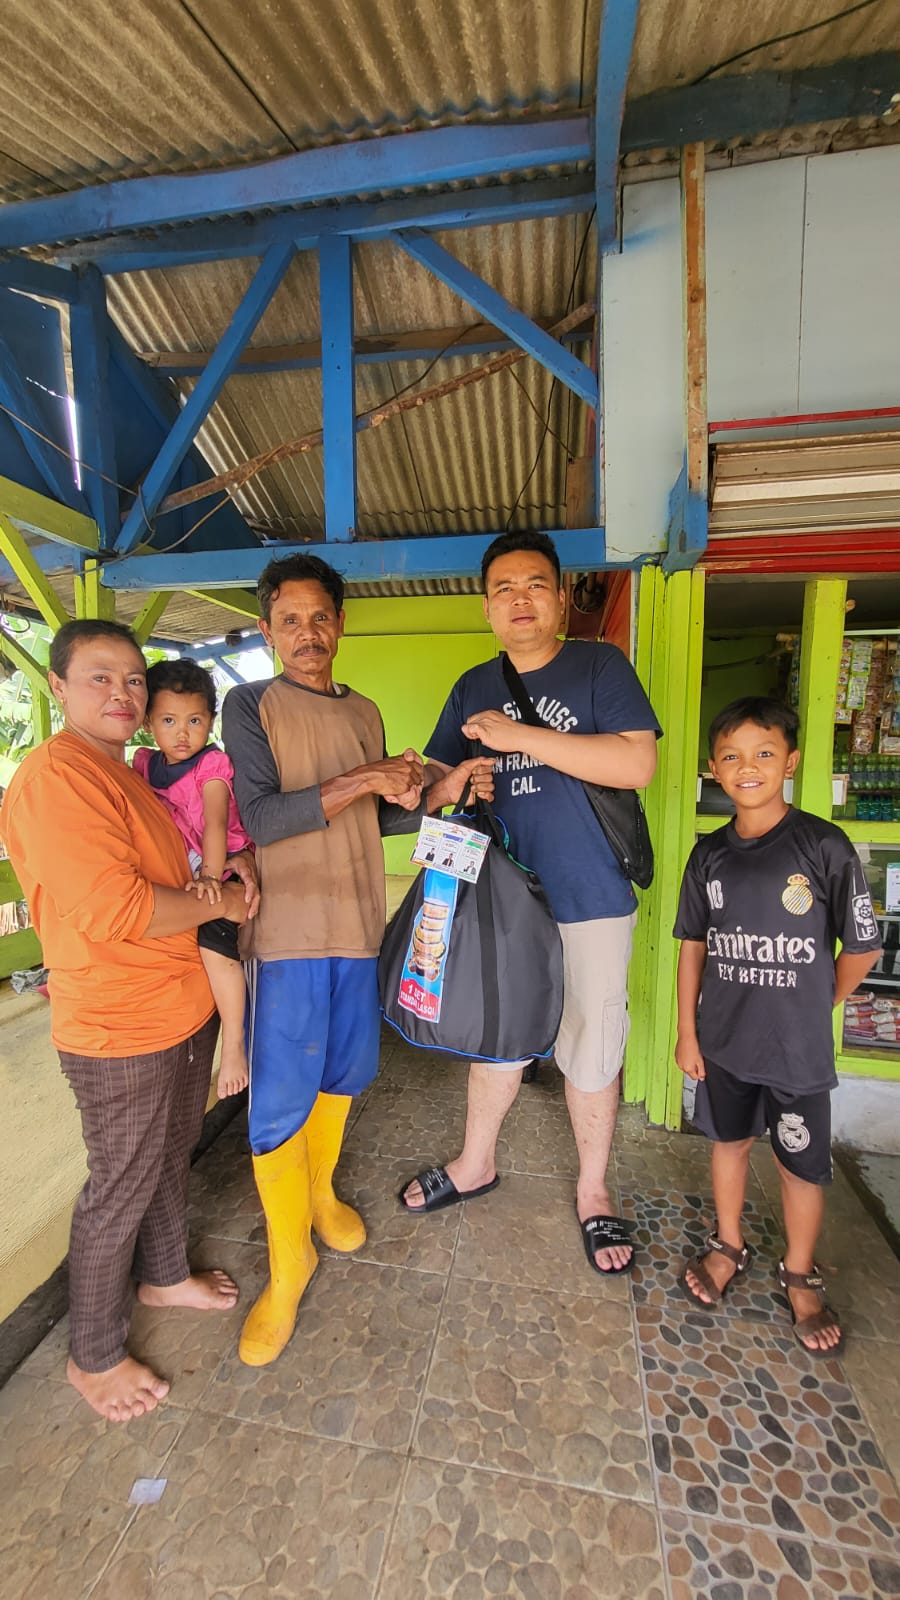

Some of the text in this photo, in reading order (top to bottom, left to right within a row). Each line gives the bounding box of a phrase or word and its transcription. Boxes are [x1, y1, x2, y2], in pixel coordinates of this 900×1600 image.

[503, 696, 578, 733] SAUSS
[511, 776, 542, 796] CAL.
[706, 925, 816, 964] Emirates
[718, 963, 797, 988] FLY BETTER
